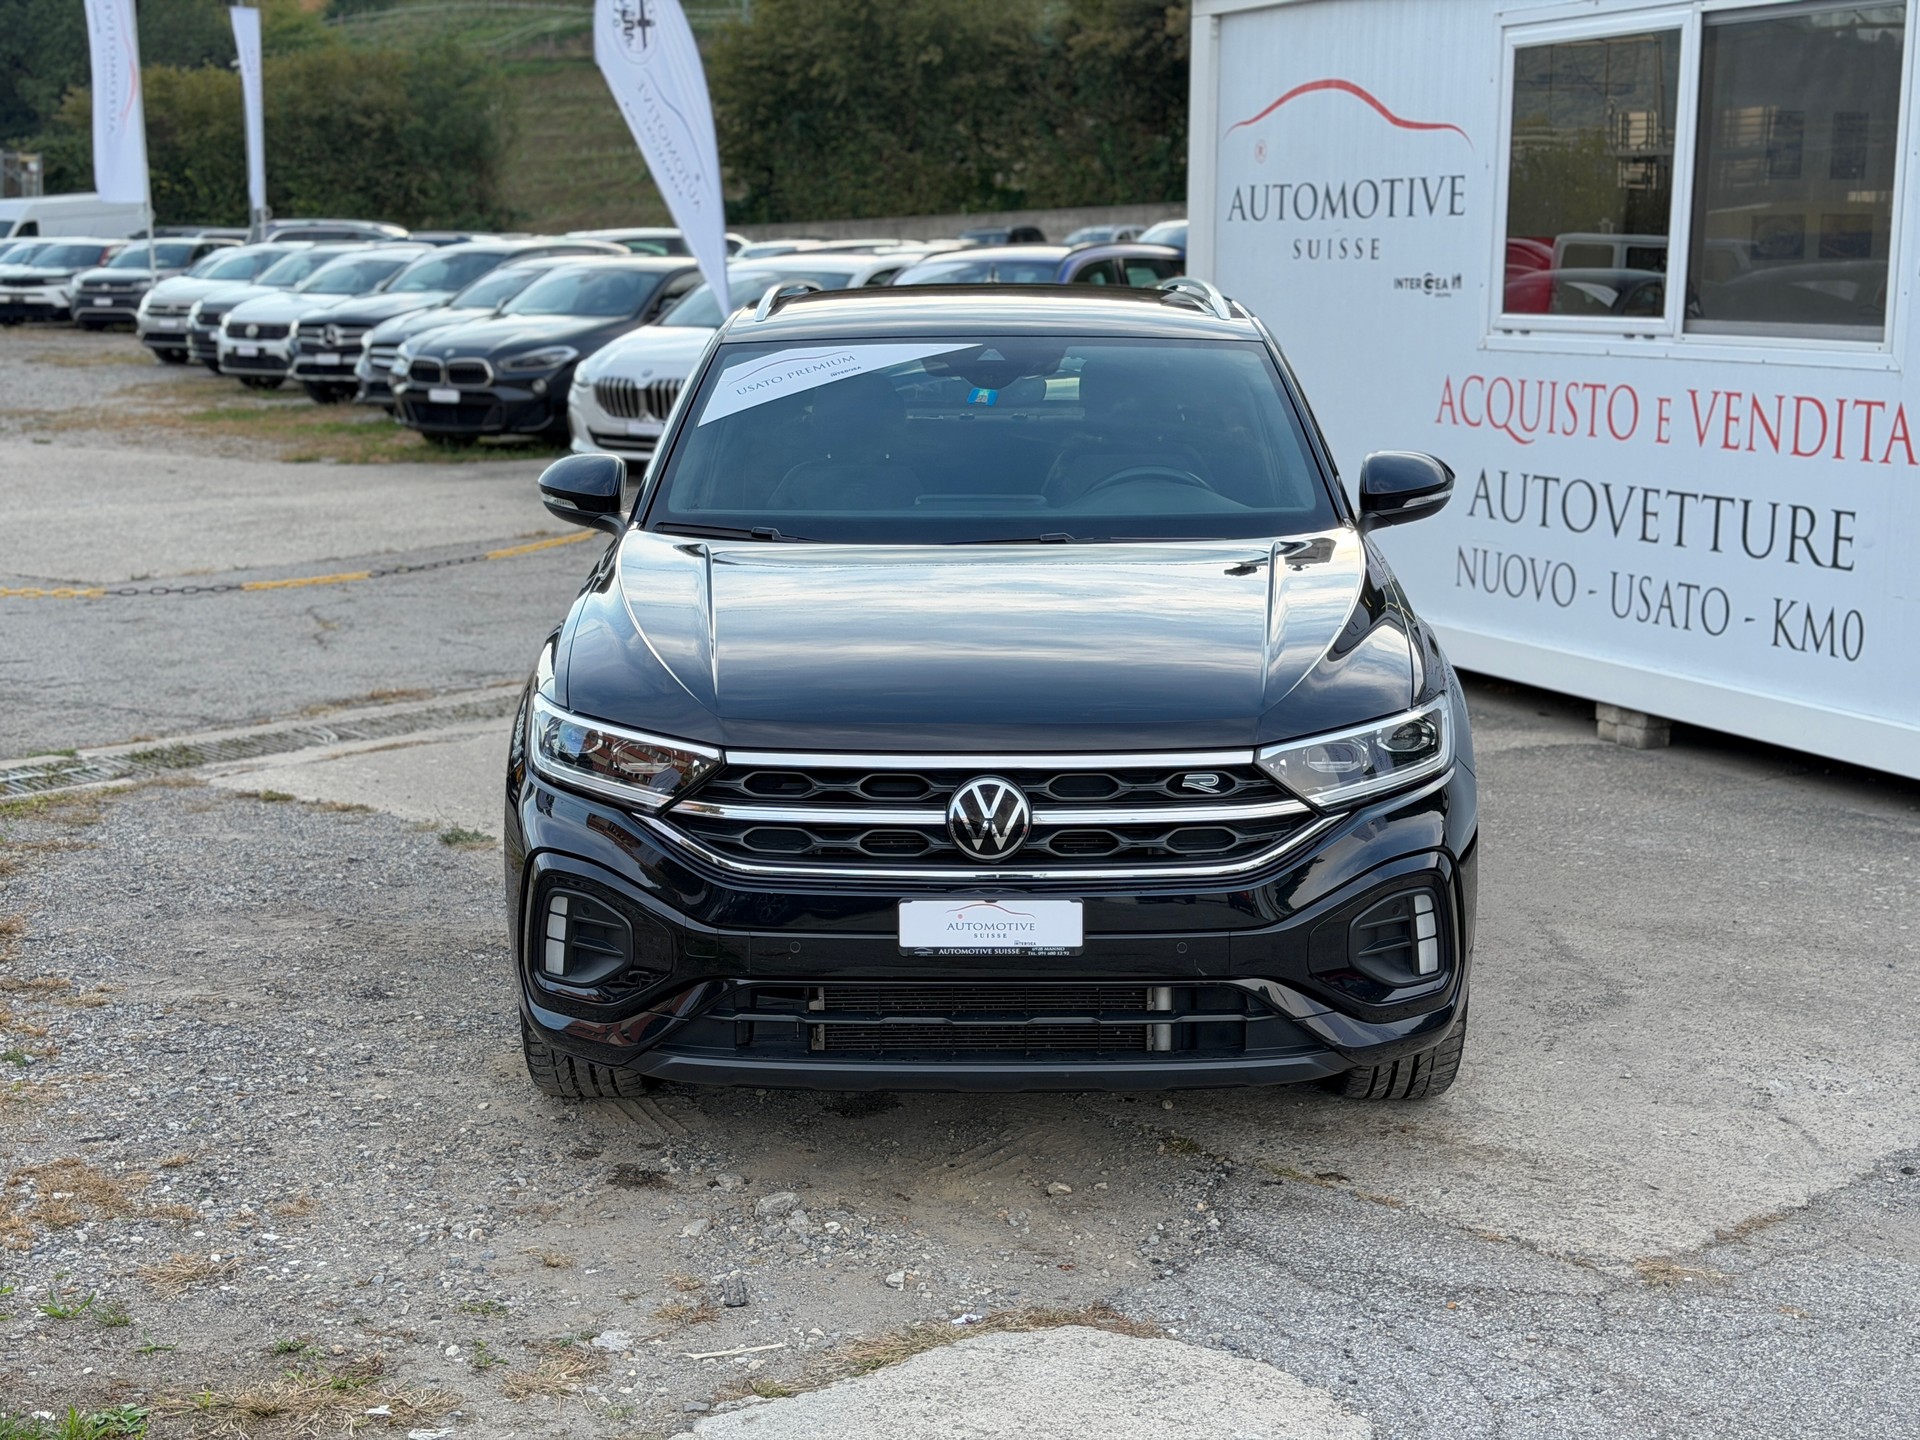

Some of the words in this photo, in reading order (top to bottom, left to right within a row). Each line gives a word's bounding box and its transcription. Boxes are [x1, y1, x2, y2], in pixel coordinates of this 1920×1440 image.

[1227, 174, 1466, 222] AUTOMOTIVE
[1292, 237, 1380, 260] SUISSE
[736, 376, 783, 395] USATO
[787, 355, 856, 379] PREMIUM
[1434, 374, 1639, 445] ACQUISTO
[1655, 397, 1672, 444] E
[1686, 389, 1919, 466] VENDITA
[1467, 468, 1857, 572] AUTOVETTURE
[1455, 546, 1577, 608] NUOVO
[1610, 571, 1731, 636] USATO
[1181, 773, 1221, 794] R
[951, 779, 1028, 856] VW
[946, 922, 1036, 931] AUTOMOTIVE
